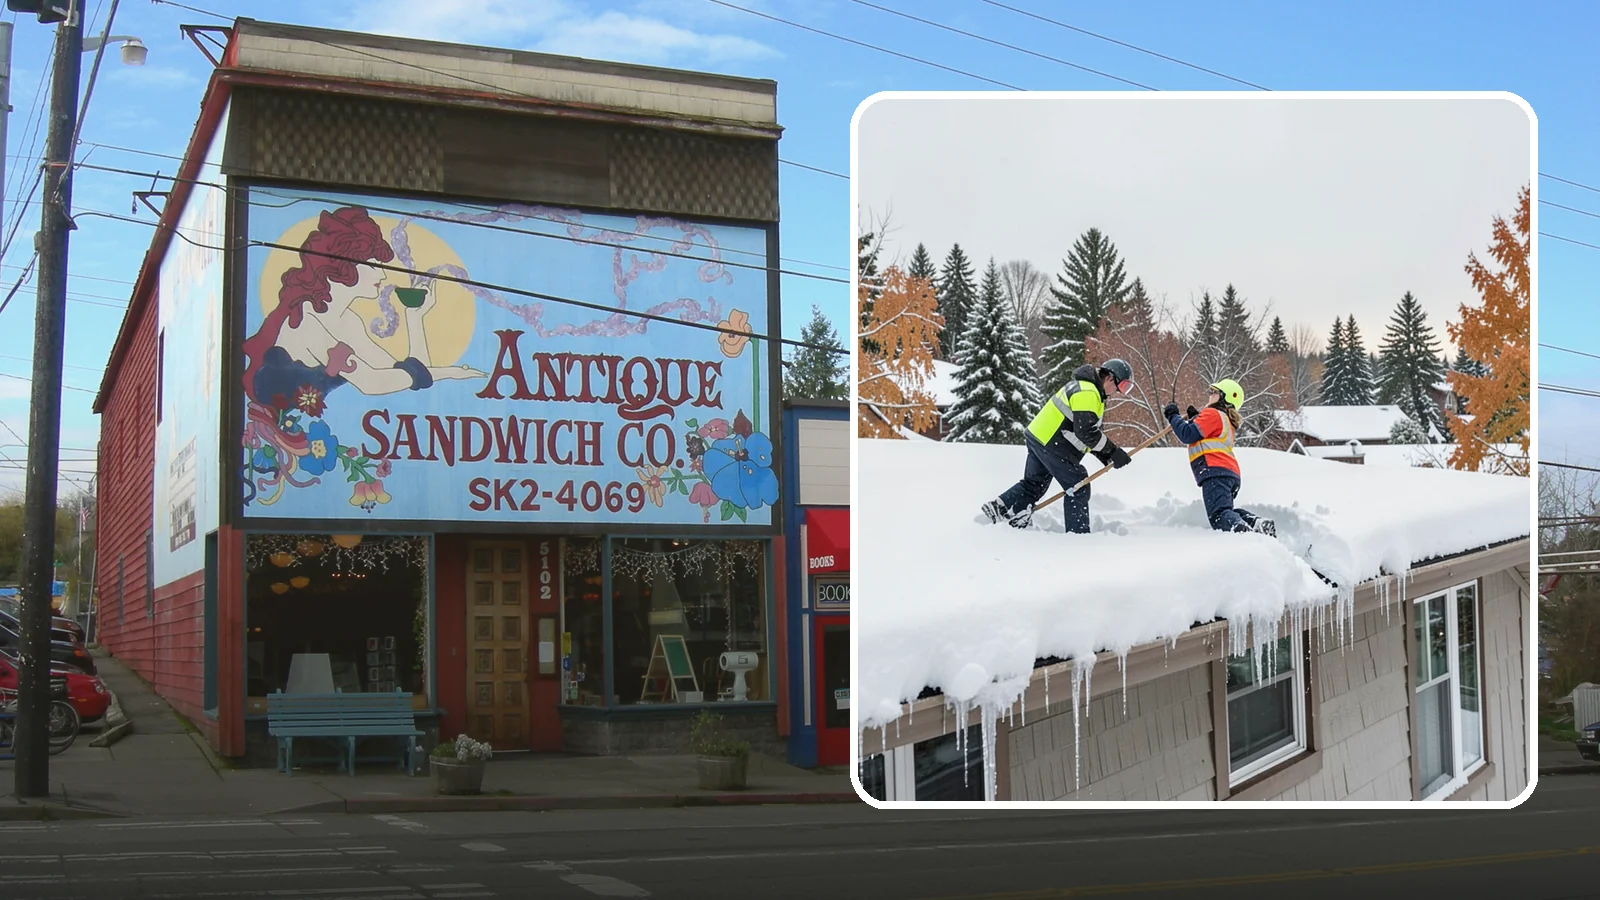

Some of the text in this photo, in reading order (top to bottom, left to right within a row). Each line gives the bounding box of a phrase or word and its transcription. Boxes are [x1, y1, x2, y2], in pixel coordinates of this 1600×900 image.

[475, 328, 724, 421] ANTIQUE
[361, 408, 685, 469] SANDWICH CO.
[468, 477, 646, 513] SK2-4069
[540, 541, 551, 600] 5102
[809, 555, 835, 569] BOOKS
